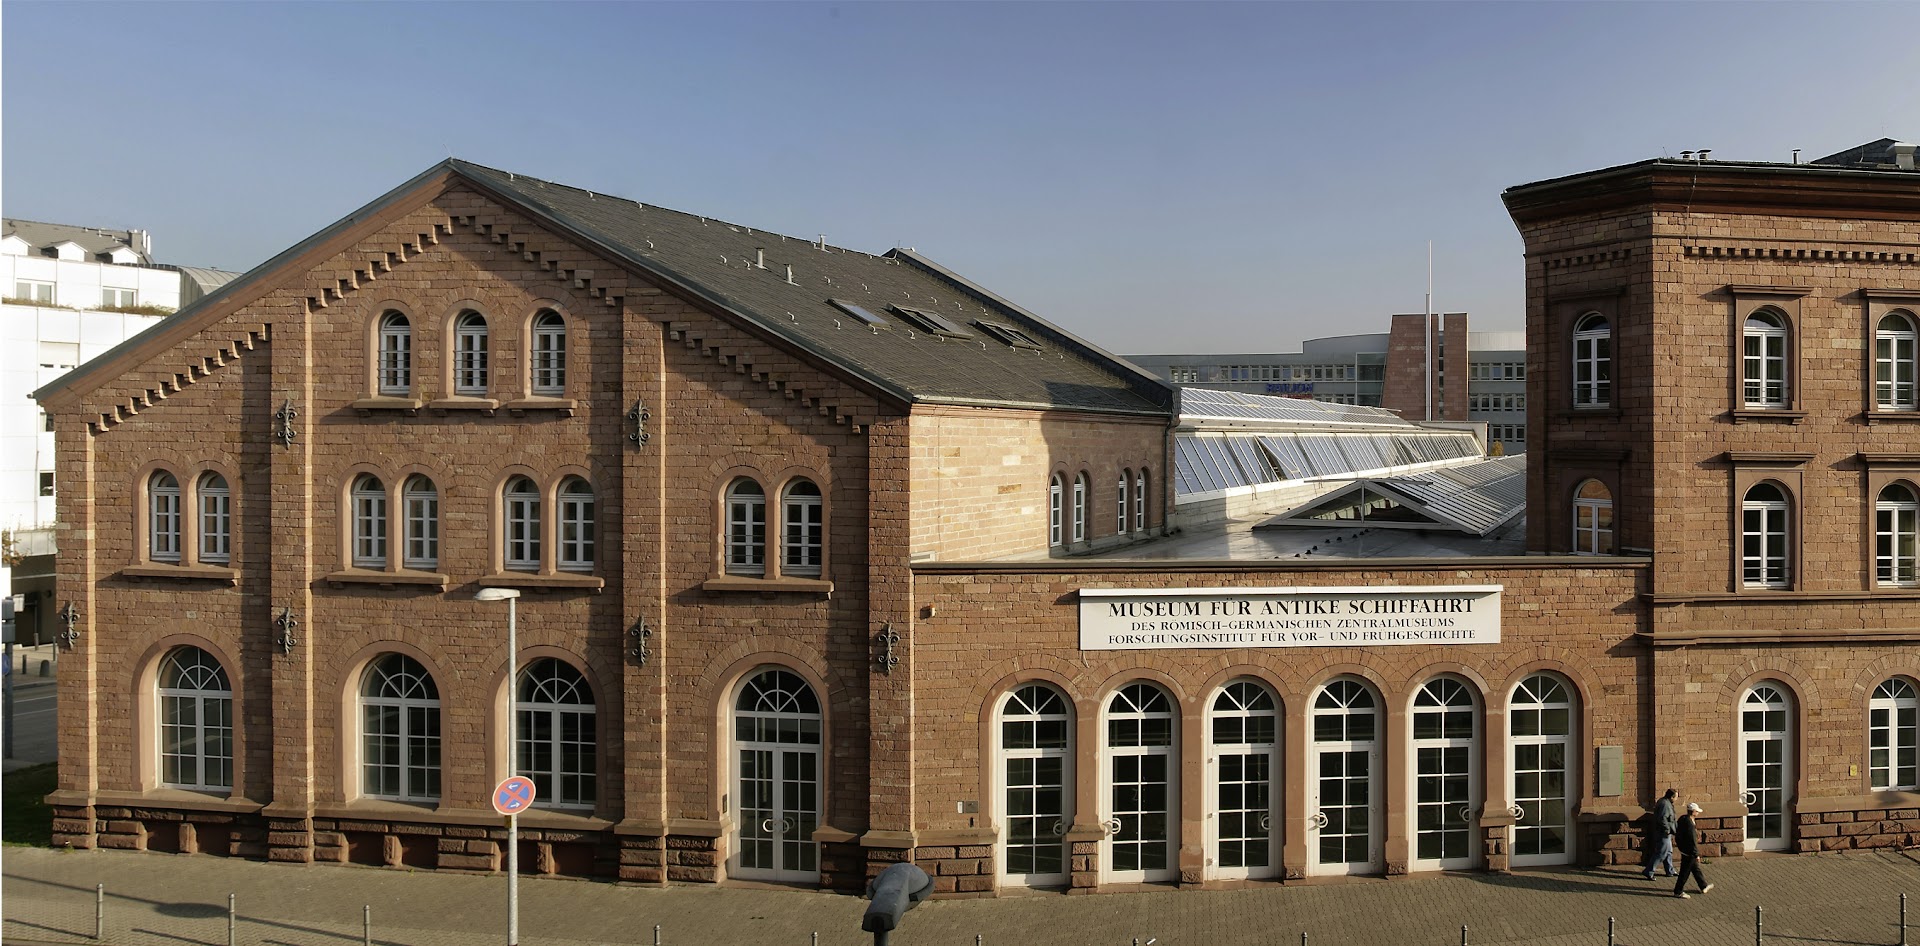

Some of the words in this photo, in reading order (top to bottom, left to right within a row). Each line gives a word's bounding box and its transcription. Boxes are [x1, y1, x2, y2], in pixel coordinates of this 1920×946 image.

[1108, 601, 1201, 618] MUSEUM
[1210, 597, 1251, 616] FÜR
[1260, 600, 1340, 616] ANTIKE
[1348, 598, 1476, 615] SCHIFFAHRT
[1131, 621, 1155, 631] DES
[1337, 617, 1455, 629] ZENTRALMUSEUMS
[1108, 632, 1256, 645] FORSCHUNGSINSTITUT
[1261, 630, 1286, 642] FÜR
[1330, 631, 1358, 641] UND
[1363, 629, 1476, 641] FRÜHGESCHICHTE
